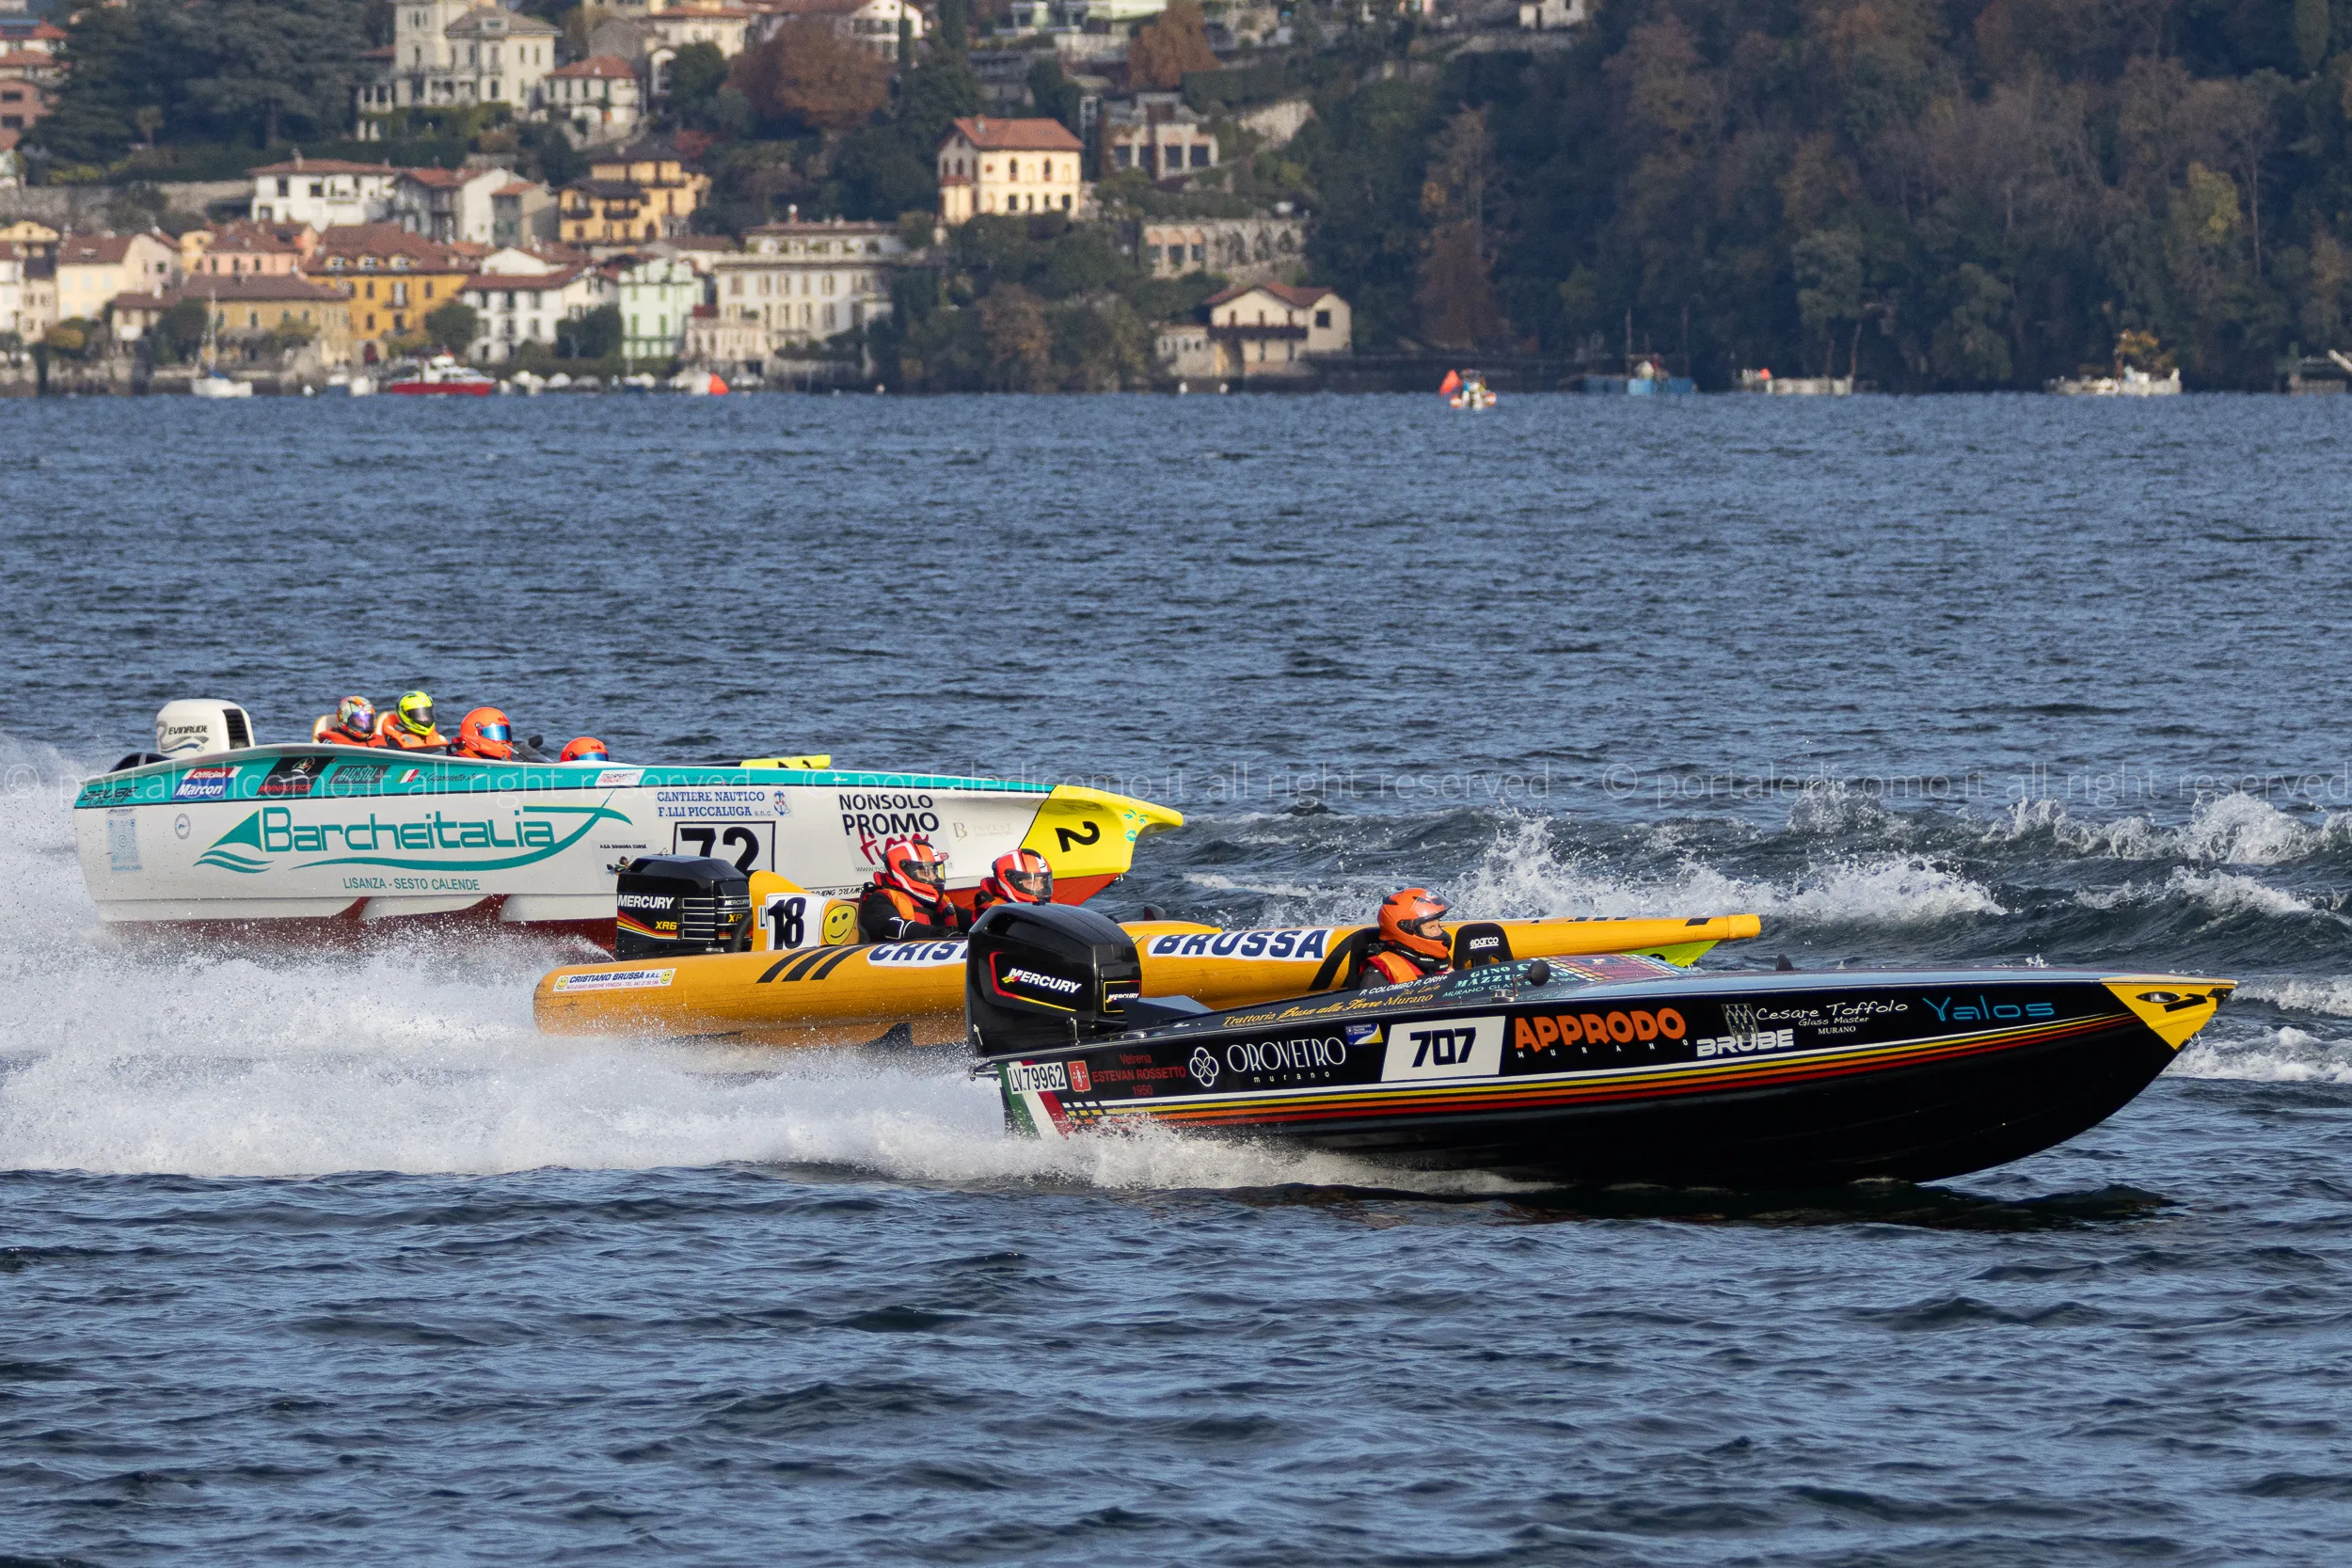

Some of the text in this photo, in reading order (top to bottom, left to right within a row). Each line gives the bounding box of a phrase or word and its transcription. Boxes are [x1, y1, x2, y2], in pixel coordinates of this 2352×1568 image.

[168, 724, 208, 735] EVINRUDE
[176, 783, 224, 797] Marcon
[657, 790, 765, 802] CANTIERE NAUTICO
[838, 794, 934, 811] NONSOLO
[658, 806, 687, 817] F.LLI
[688, 806, 753, 816] PICCALUGA
[841, 812, 940, 836] PROMO
[1055, 820, 1101, 853] 2
[343, 877, 387, 890] LISANZA
[394, 878, 428, 890] SESTO
[432, 878, 481, 890] CALENDE
[617, 895, 675, 909] MERCURY
[655, 921, 677, 929] XR6
[768, 896, 806, 950] 18
[1152, 929, 1329, 958] BRUSSA
[569, 974, 612, 984] CRISTIANO
[612, 972, 644, 981] BRUSSA
[1470, 966, 1511, 978] GINO
[1009, 968, 1082, 993] MERCURY
[1369, 981, 1413, 995] COLOMBO
[1442, 986, 1484, 998] MURANO
[1223, 1011, 1277, 1026] Trattoria
[1278, 1006, 1315, 1021] Busa
[1316, 1002, 1344, 1015] alla
[1383, 993, 1434, 1006] Murano
[1756, 999, 1908, 1021] Cesare Toffolo
[1923, 995, 2055, 1022] Yalos
[1798, 1016, 1870, 1026] Glass Master
[1515, 1007, 1686, 1053] APPRODO
[1818, 1025, 1856, 1035] MURANO
[1409, 1027, 1476, 1068] 707
[1518, 1038, 1688, 1058] MURANO
[1696, 1028, 1794, 1057] BRUBE
[1119, 1053, 1152, 1065] Vetreria
[1227, 1037, 1346, 1072] OROVETRO
[1091, 1066, 1186, 1082] ESTEVAN ROSSETTO
[1253, 1070, 1330, 1084] murano
[1132, 1085, 1153, 1097] 1950
